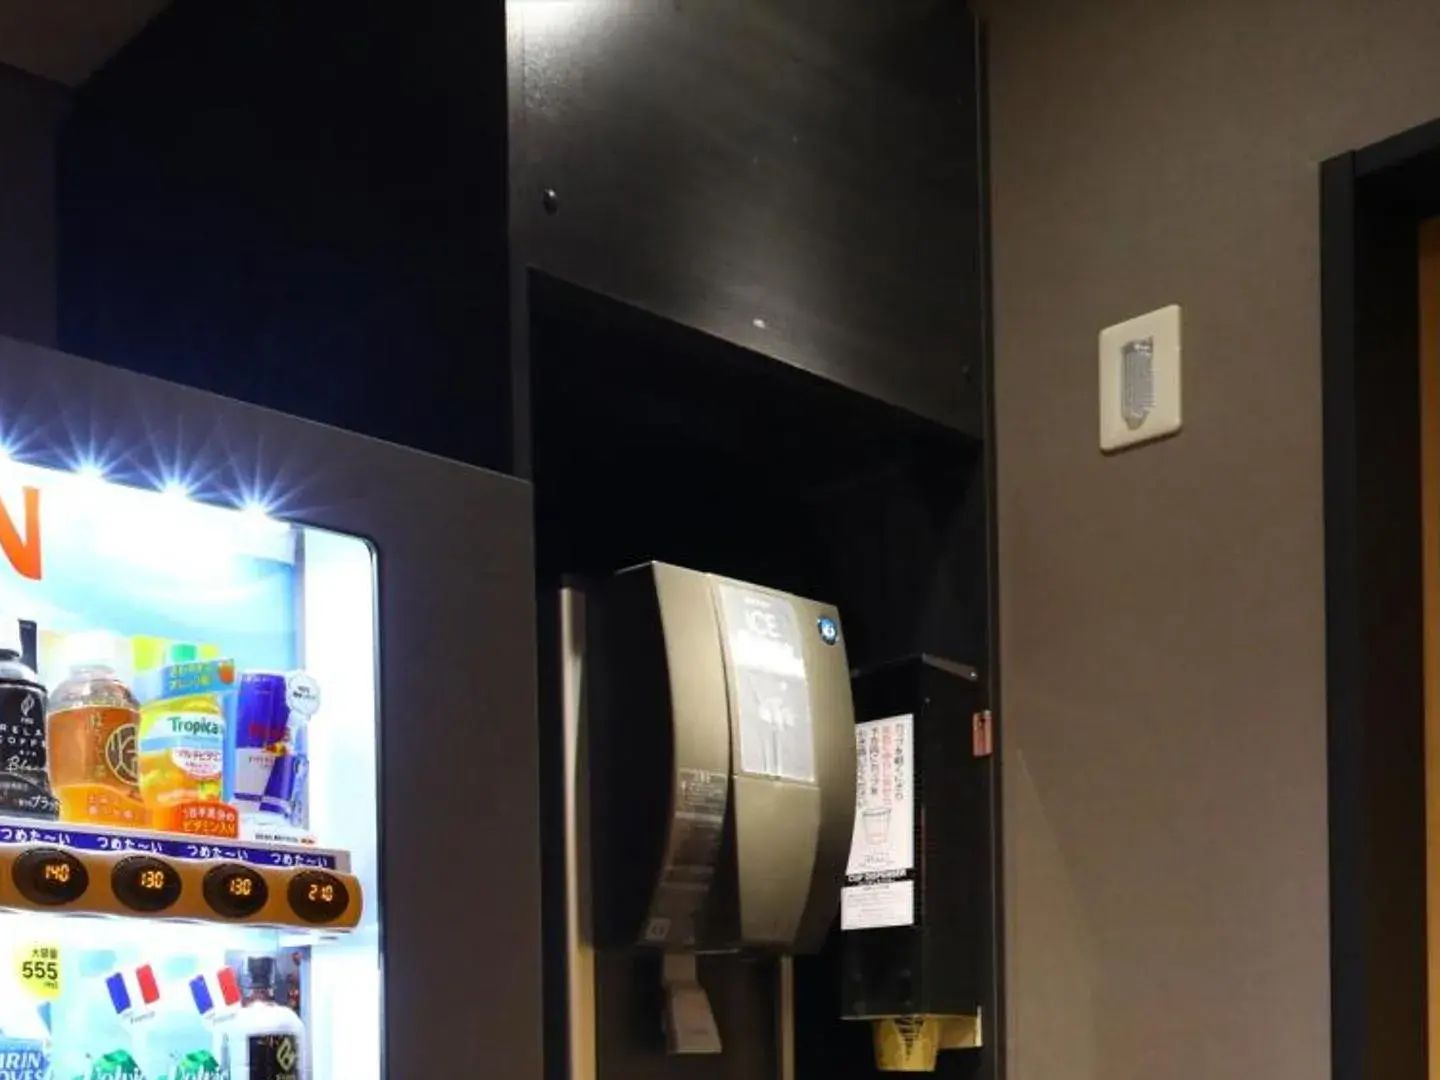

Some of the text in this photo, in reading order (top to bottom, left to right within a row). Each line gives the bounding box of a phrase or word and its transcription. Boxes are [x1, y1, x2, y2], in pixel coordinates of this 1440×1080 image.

[0, 723, 43, 737] RELA
[45, 863, 70, 883] 140
[140, 864, 165, 890] 130
[230, 876, 252, 897] 130
[309, 883, 334, 902] 210
[22, 962, 59, 980] 555
